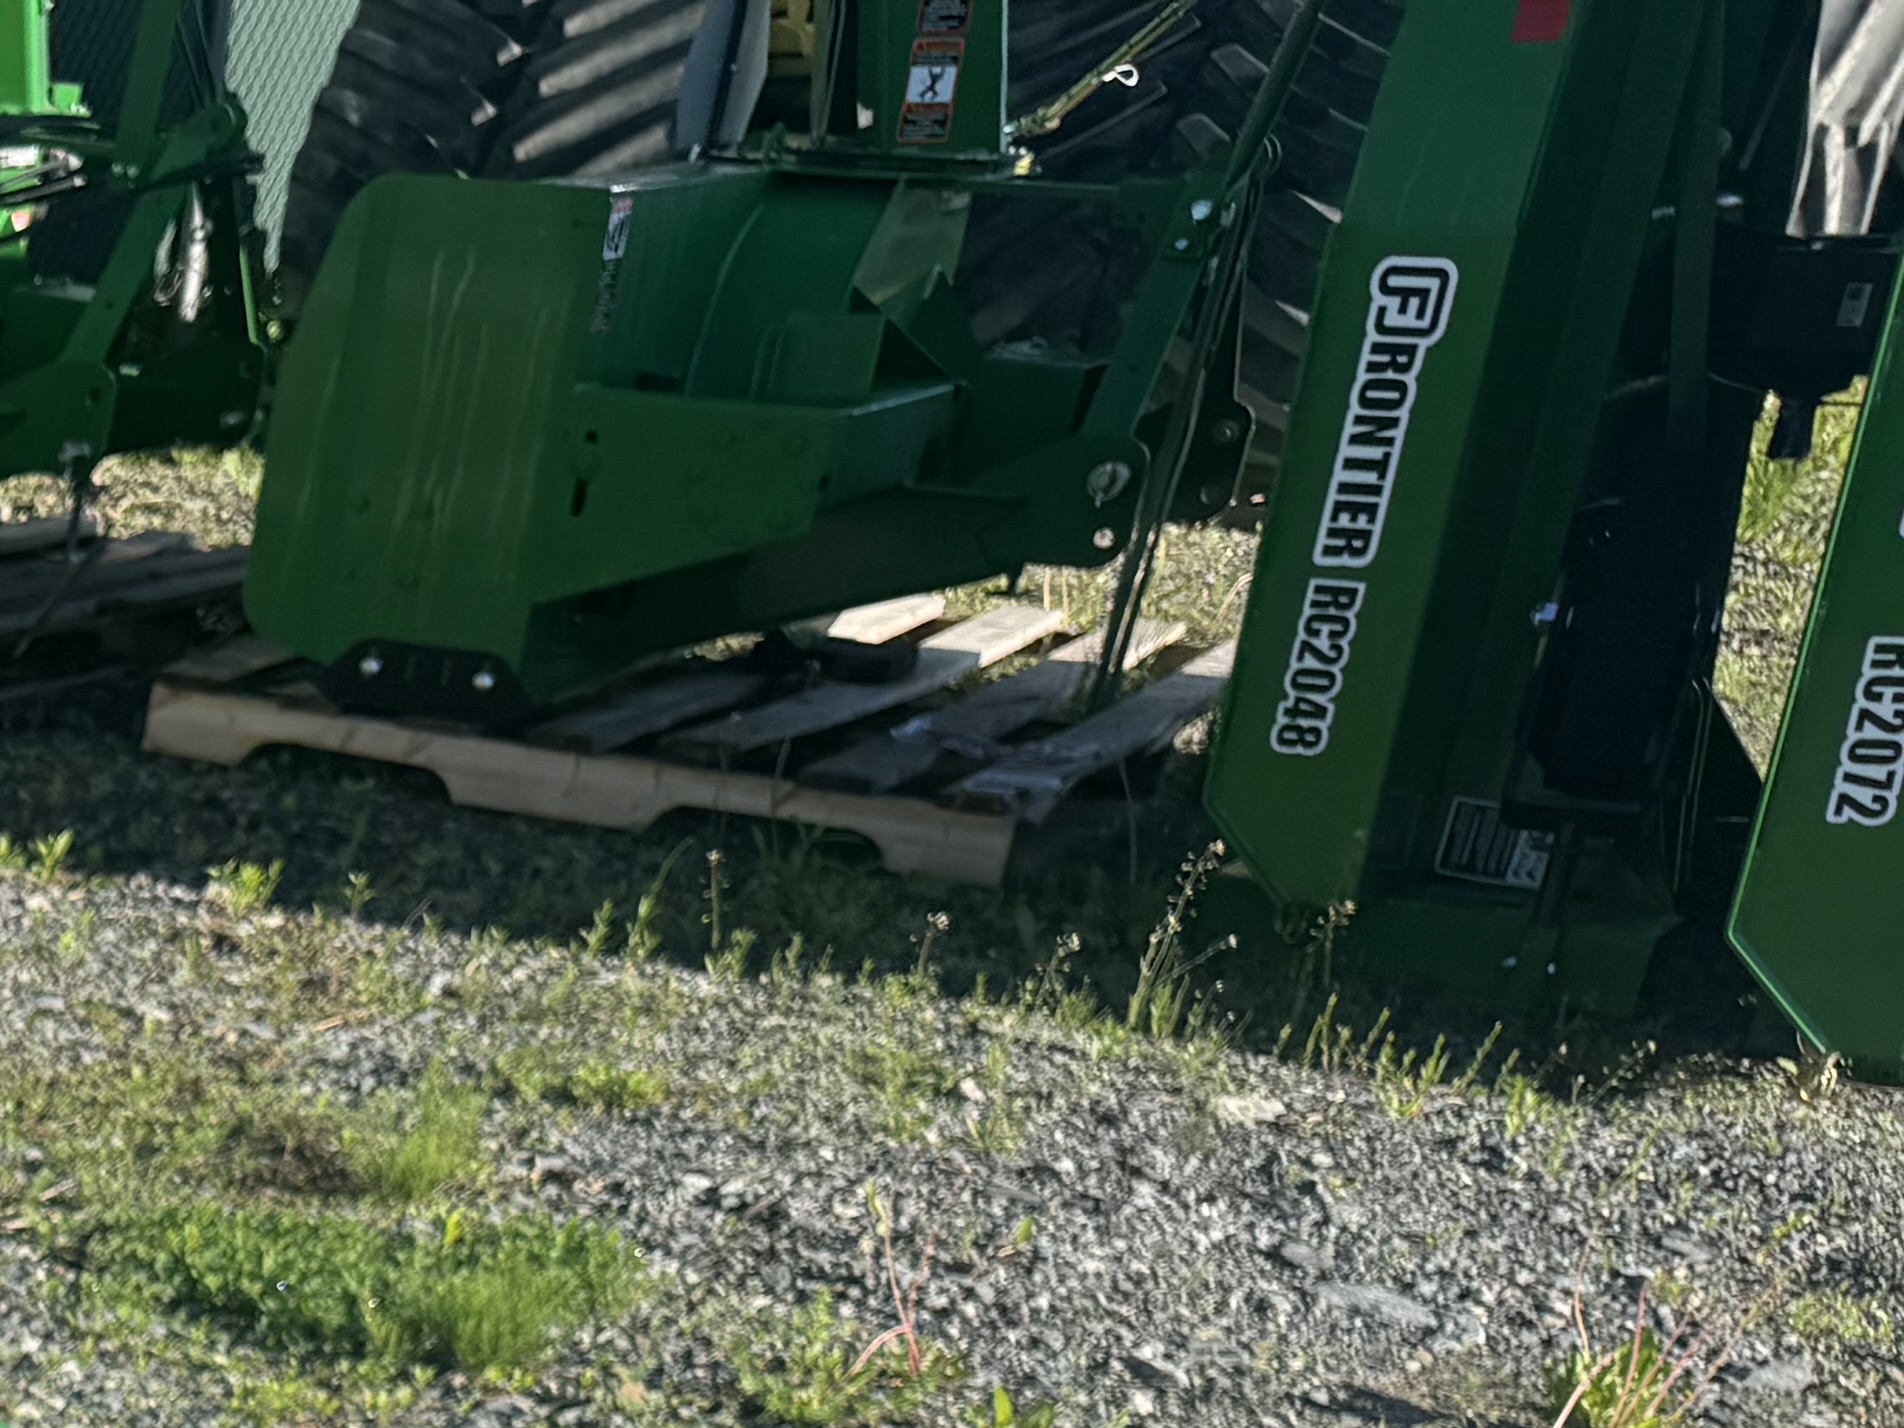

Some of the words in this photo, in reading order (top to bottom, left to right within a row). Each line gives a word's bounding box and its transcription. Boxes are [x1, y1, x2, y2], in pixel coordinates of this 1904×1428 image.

[1320, 263, 1452, 562] FRONTIER
[1275, 582, 1361, 752] RC2048
[1832, 642, 1904, 821] RC2072
